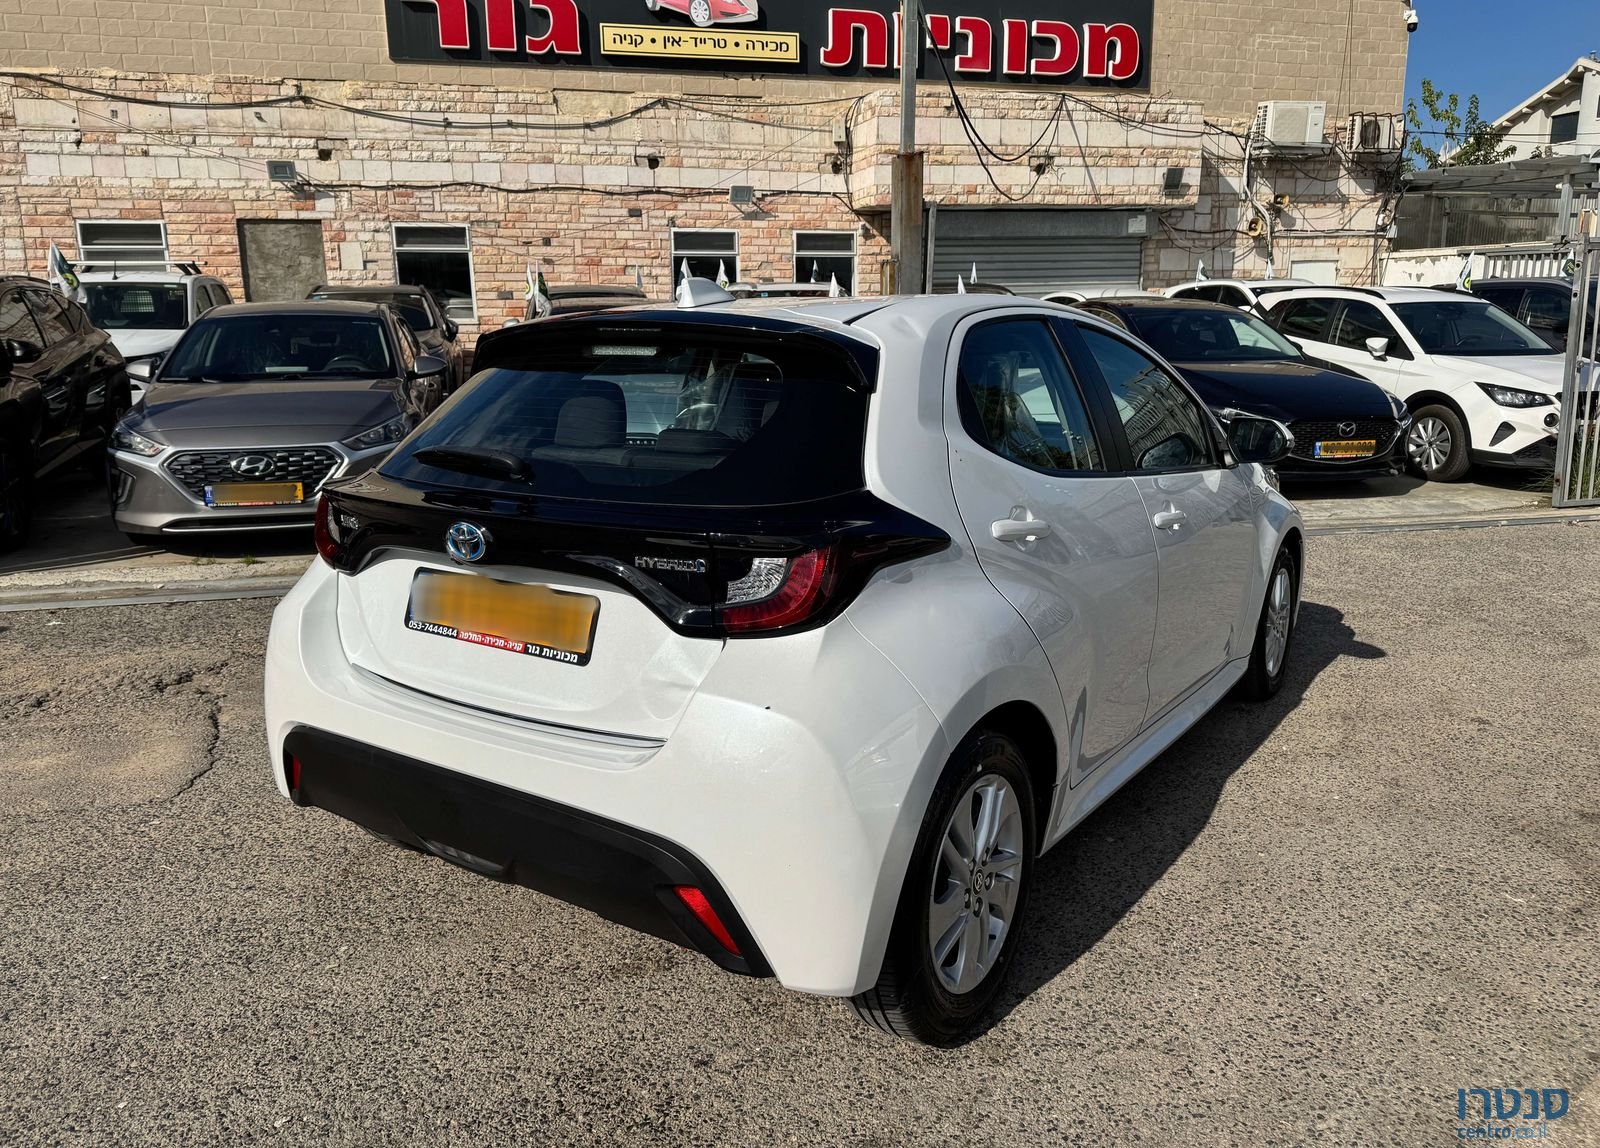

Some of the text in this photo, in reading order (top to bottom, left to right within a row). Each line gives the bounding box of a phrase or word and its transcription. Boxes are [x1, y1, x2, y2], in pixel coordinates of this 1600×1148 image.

[402, 0, 582, 55] גור
[612, 32, 790, 53] מכירה טרייד-אין קניה
[634, 556, 695, 572] HYBRID
[408, 619, 458, 638] 053-7444844
[526, 643, 540, 655] גור
[542, 646, 579, 663] מכוניות
